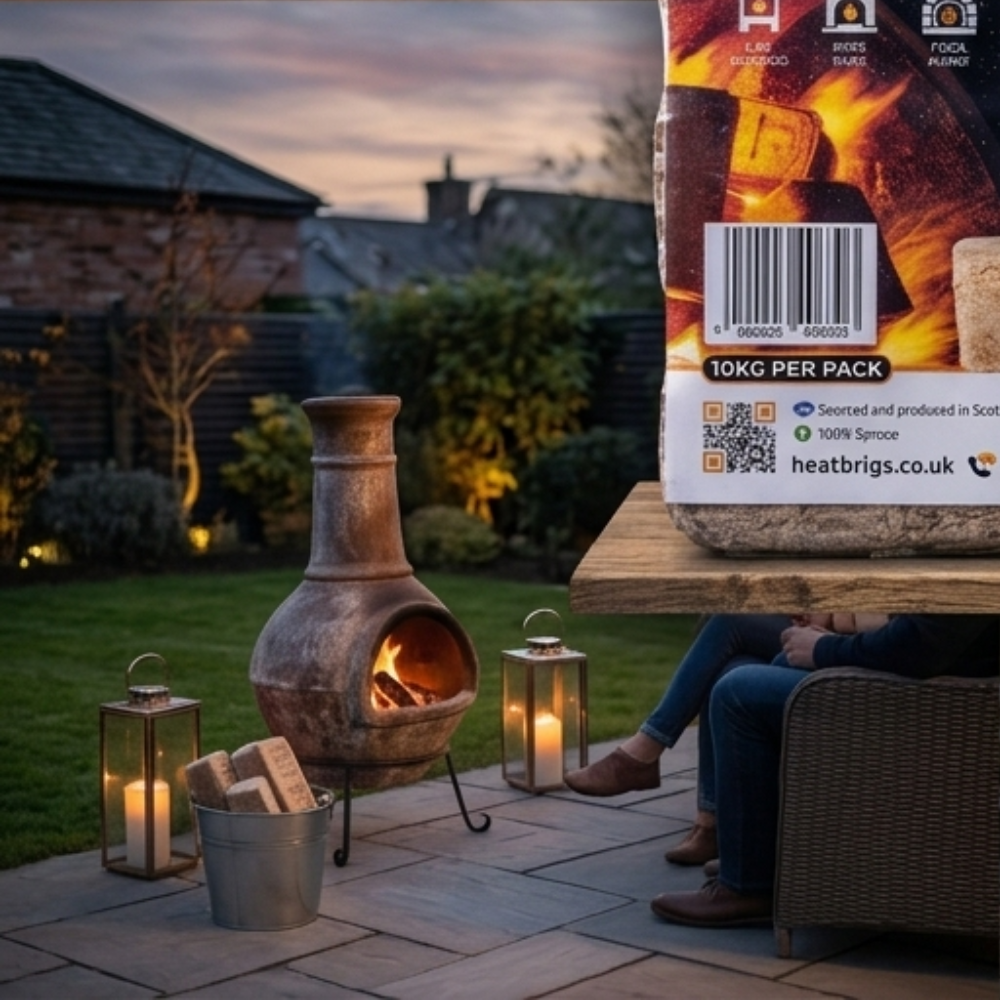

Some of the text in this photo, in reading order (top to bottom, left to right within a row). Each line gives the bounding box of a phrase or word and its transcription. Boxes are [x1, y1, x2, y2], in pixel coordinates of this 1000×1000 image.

[711, 361, 883, 376] 10KG PER PACK
[871, 404, 894, 417] and
[898, 404, 956, 420] produced
[959, 405, 969, 417] in
